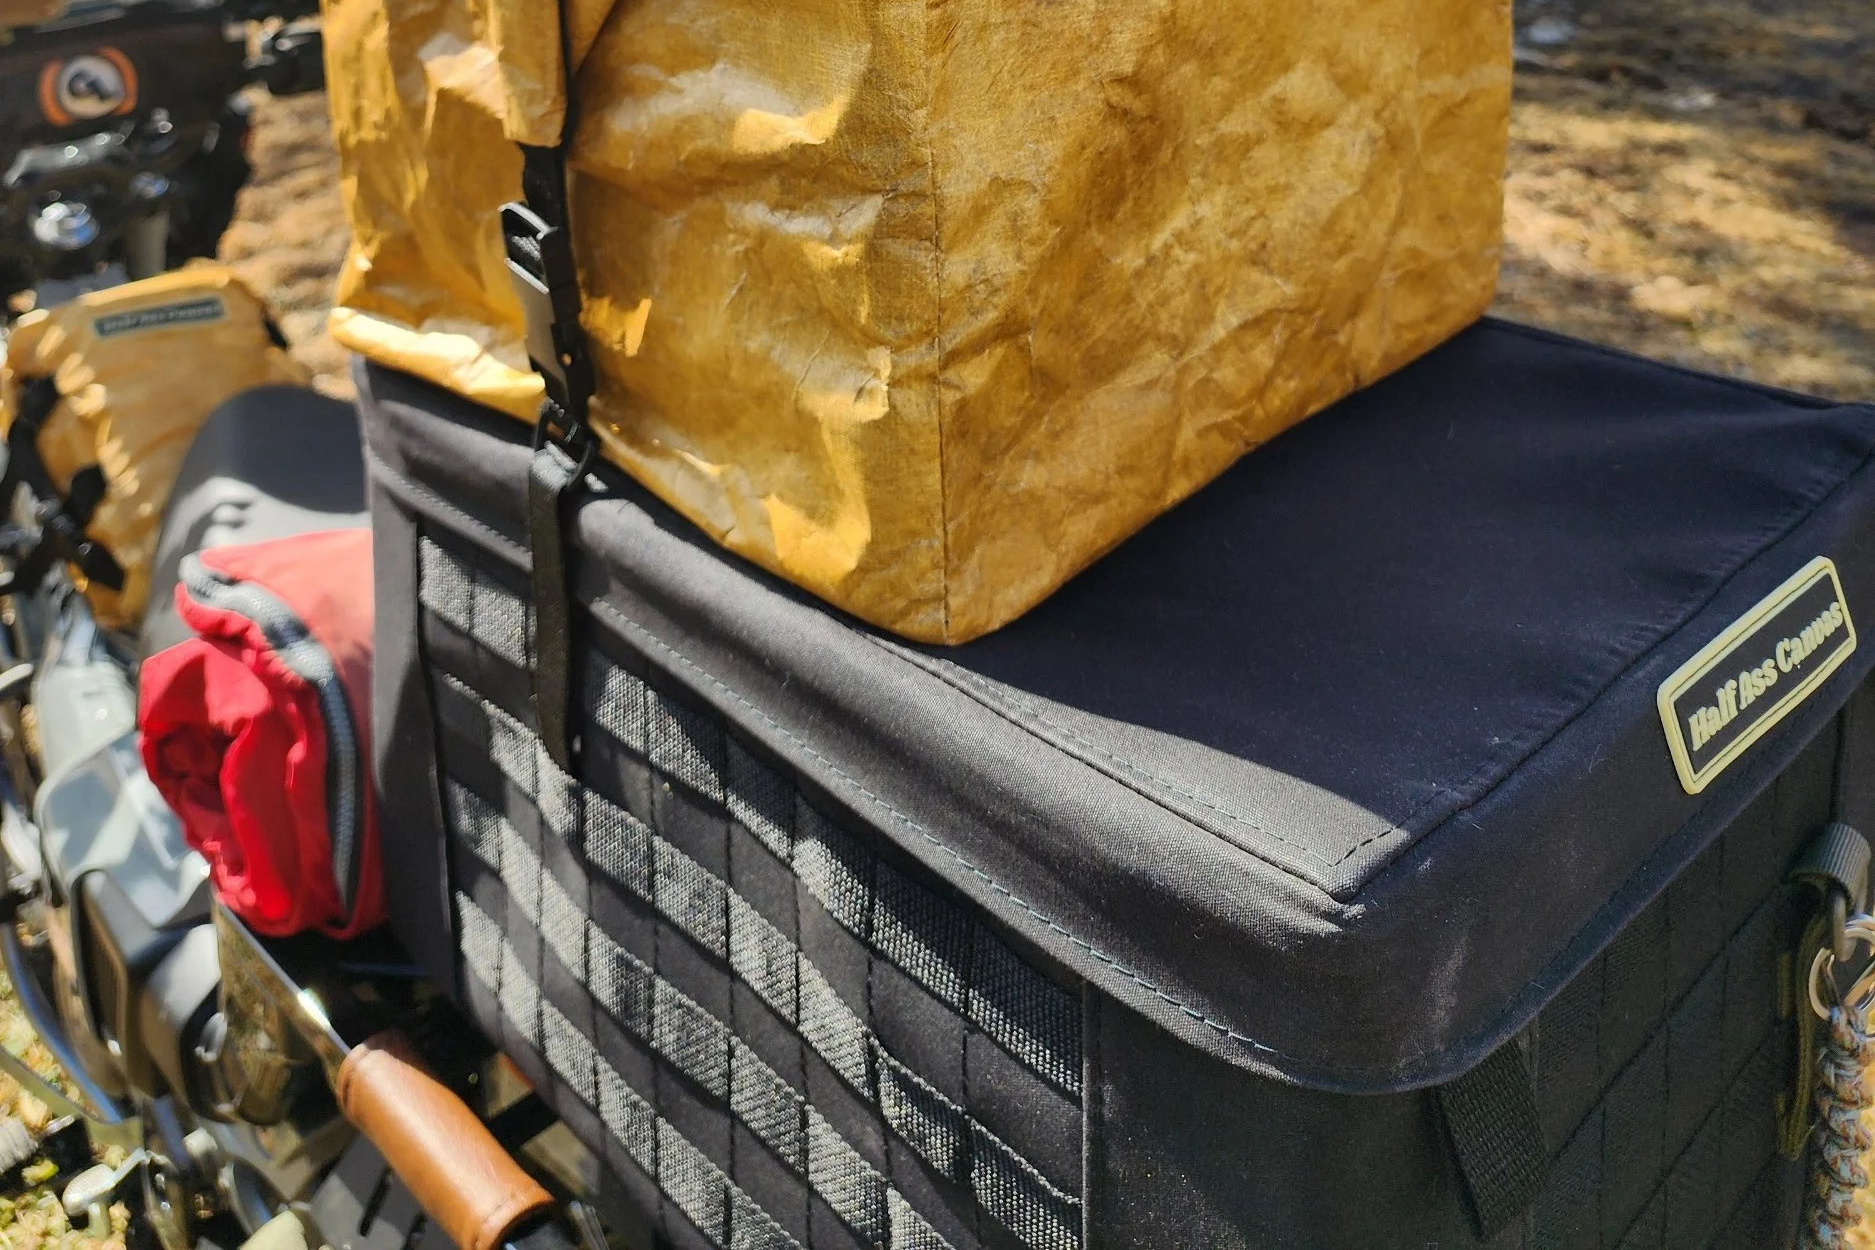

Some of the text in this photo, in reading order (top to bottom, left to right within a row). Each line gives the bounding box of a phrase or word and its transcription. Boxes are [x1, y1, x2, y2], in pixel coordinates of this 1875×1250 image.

[1688, 601, 1843, 751] Half Ass Canvas
